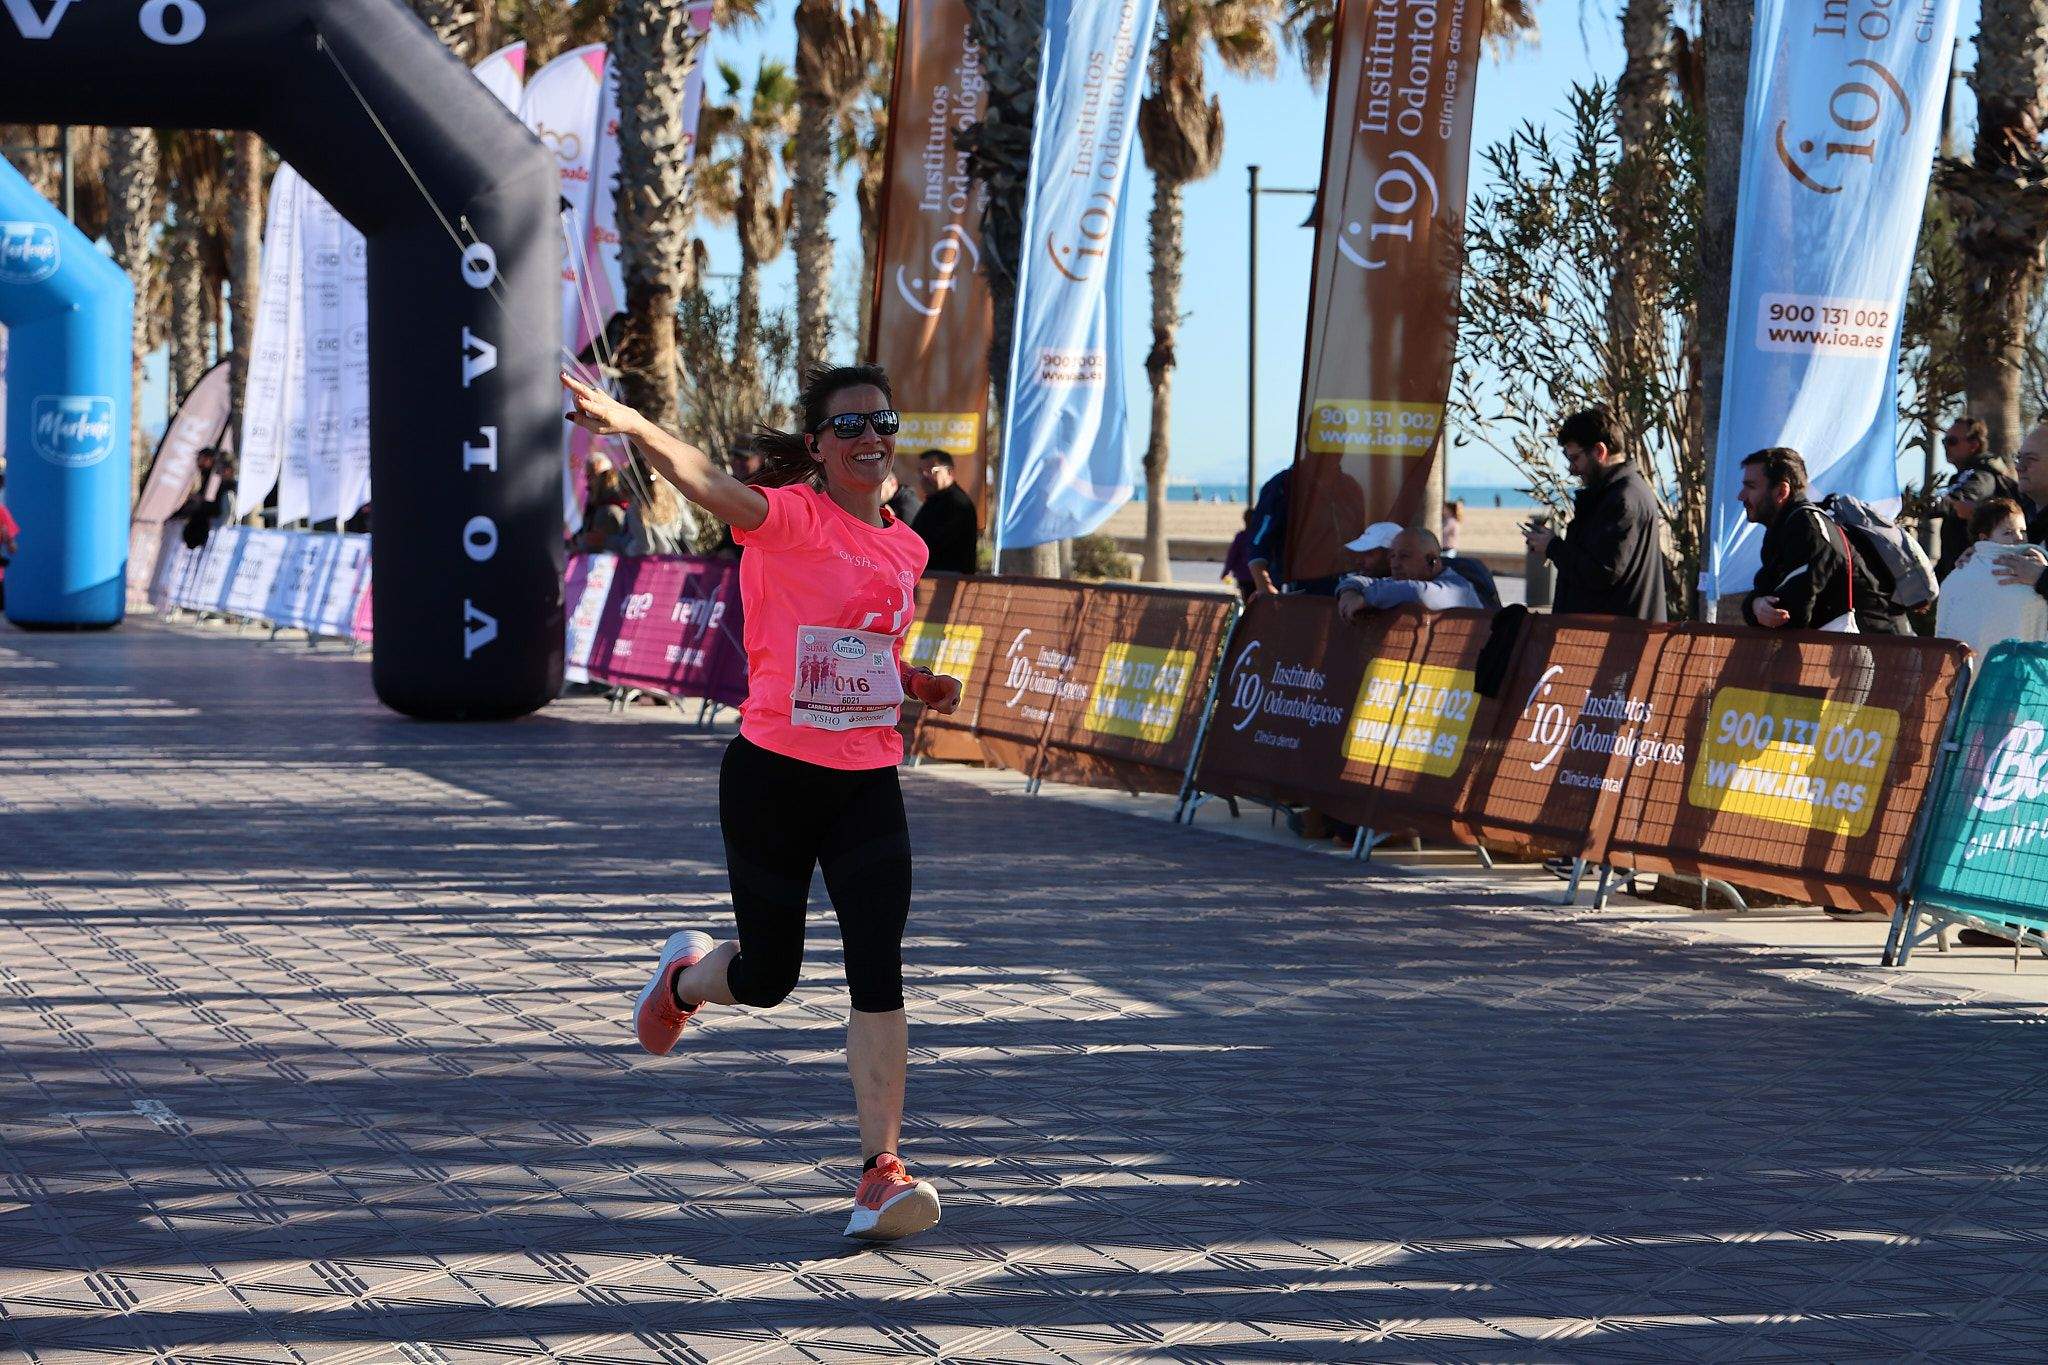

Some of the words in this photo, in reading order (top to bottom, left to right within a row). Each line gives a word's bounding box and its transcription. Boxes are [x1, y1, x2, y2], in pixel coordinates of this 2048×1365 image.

[1072, 51, 1104, 178] Institutos
[919, 85, 949, 213] Institutos
[1770, 303, 1815, 323] 900
[1822, 307, 1848, 325] 131
[1855, 310, 1889, 328] 002
[1768, 328, 1884, 348] www.ioa.es
[1320, 407, 1361, 426] 900
[1364, 410, 1393, 428] 131
[1399, 411, 1435, 429] 002
[461, 241, 499, 660] VOLVO
[1320, 428, 1434, 447] www.ioa.es
[1272, 661, 1327, 690] Institutos
[807, 703, 832, 712] CARRERA
[1363, 677, 1405, 709] 900
[1432, 687, 1473, 722] 002
[1579, 689, 1654, 724] Institutos
[1717, 709, 1775, 750] 900
[1778, 717, 1821, 758] 131
[1824, 725, 1882, 769] 002
[1588, 774, 1624, 794] dental
[1707, 758, 1867, 814] www.ioa.es
